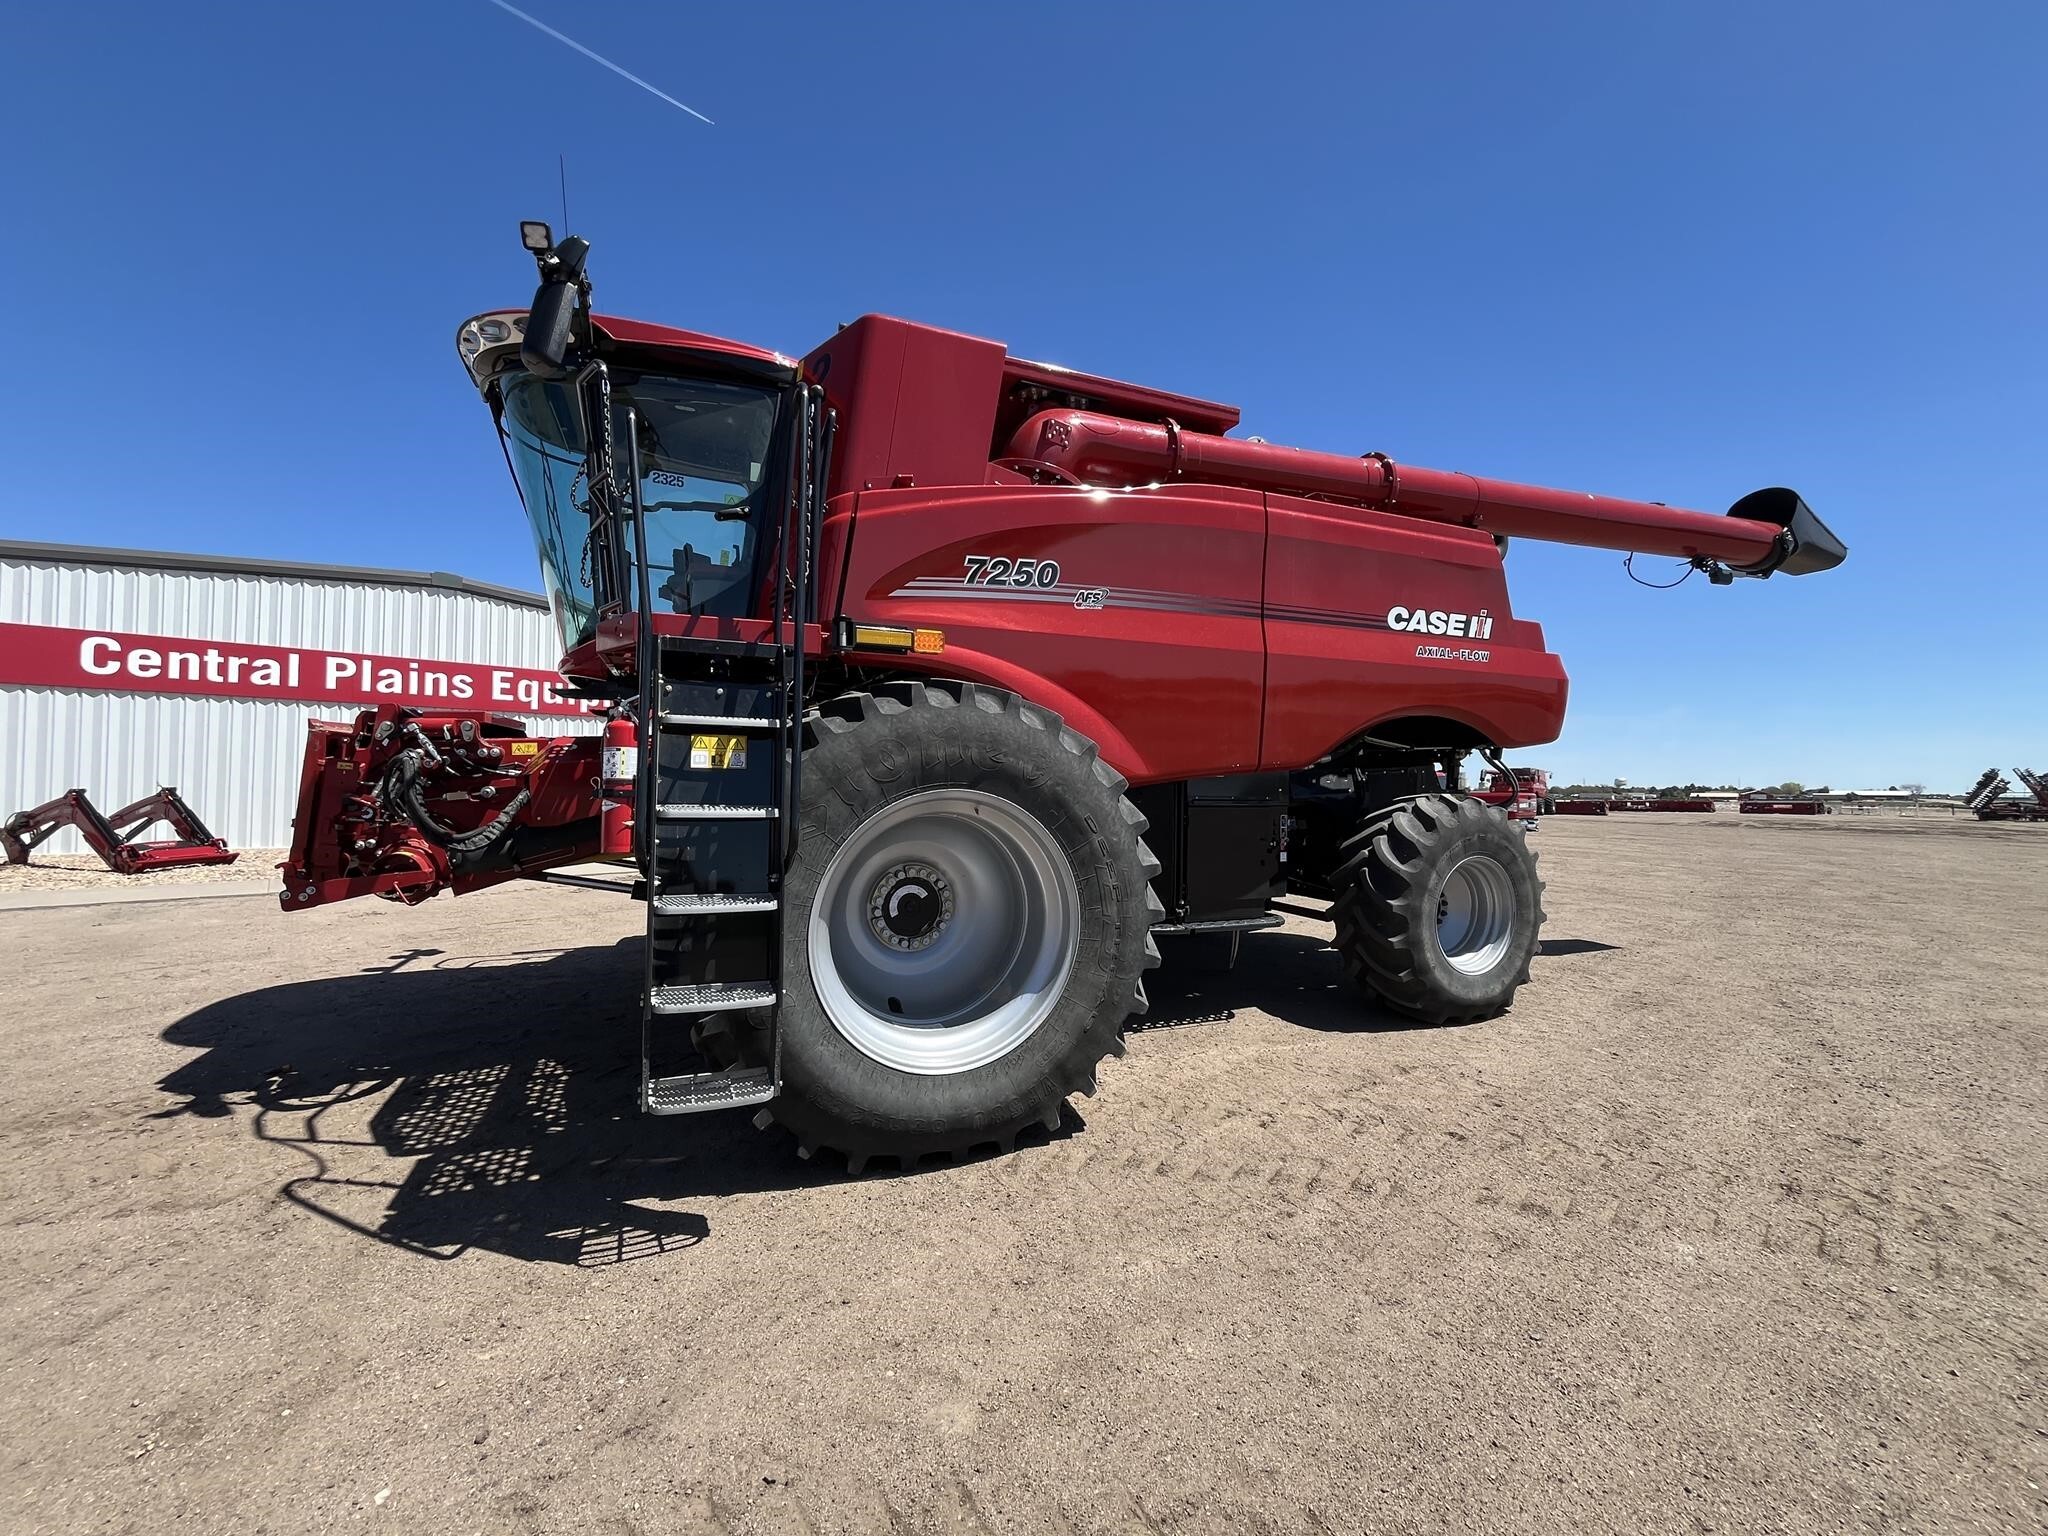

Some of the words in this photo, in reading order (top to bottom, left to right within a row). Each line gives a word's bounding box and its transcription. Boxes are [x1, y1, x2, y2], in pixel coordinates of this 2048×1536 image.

[652, 472, 685, 488] 2325
[964, 555, 1060, 589] 7250
[1074, 589, 1103, 604] AFS
[1387, 606, 1467, 637] CASE
[1416, 645, 1490, 662] AXIAL-FLOW
[80, 636, 299, 687] Central
[325, 656, 474, 699] Plains
[491, 670, 611, 713] Equ
